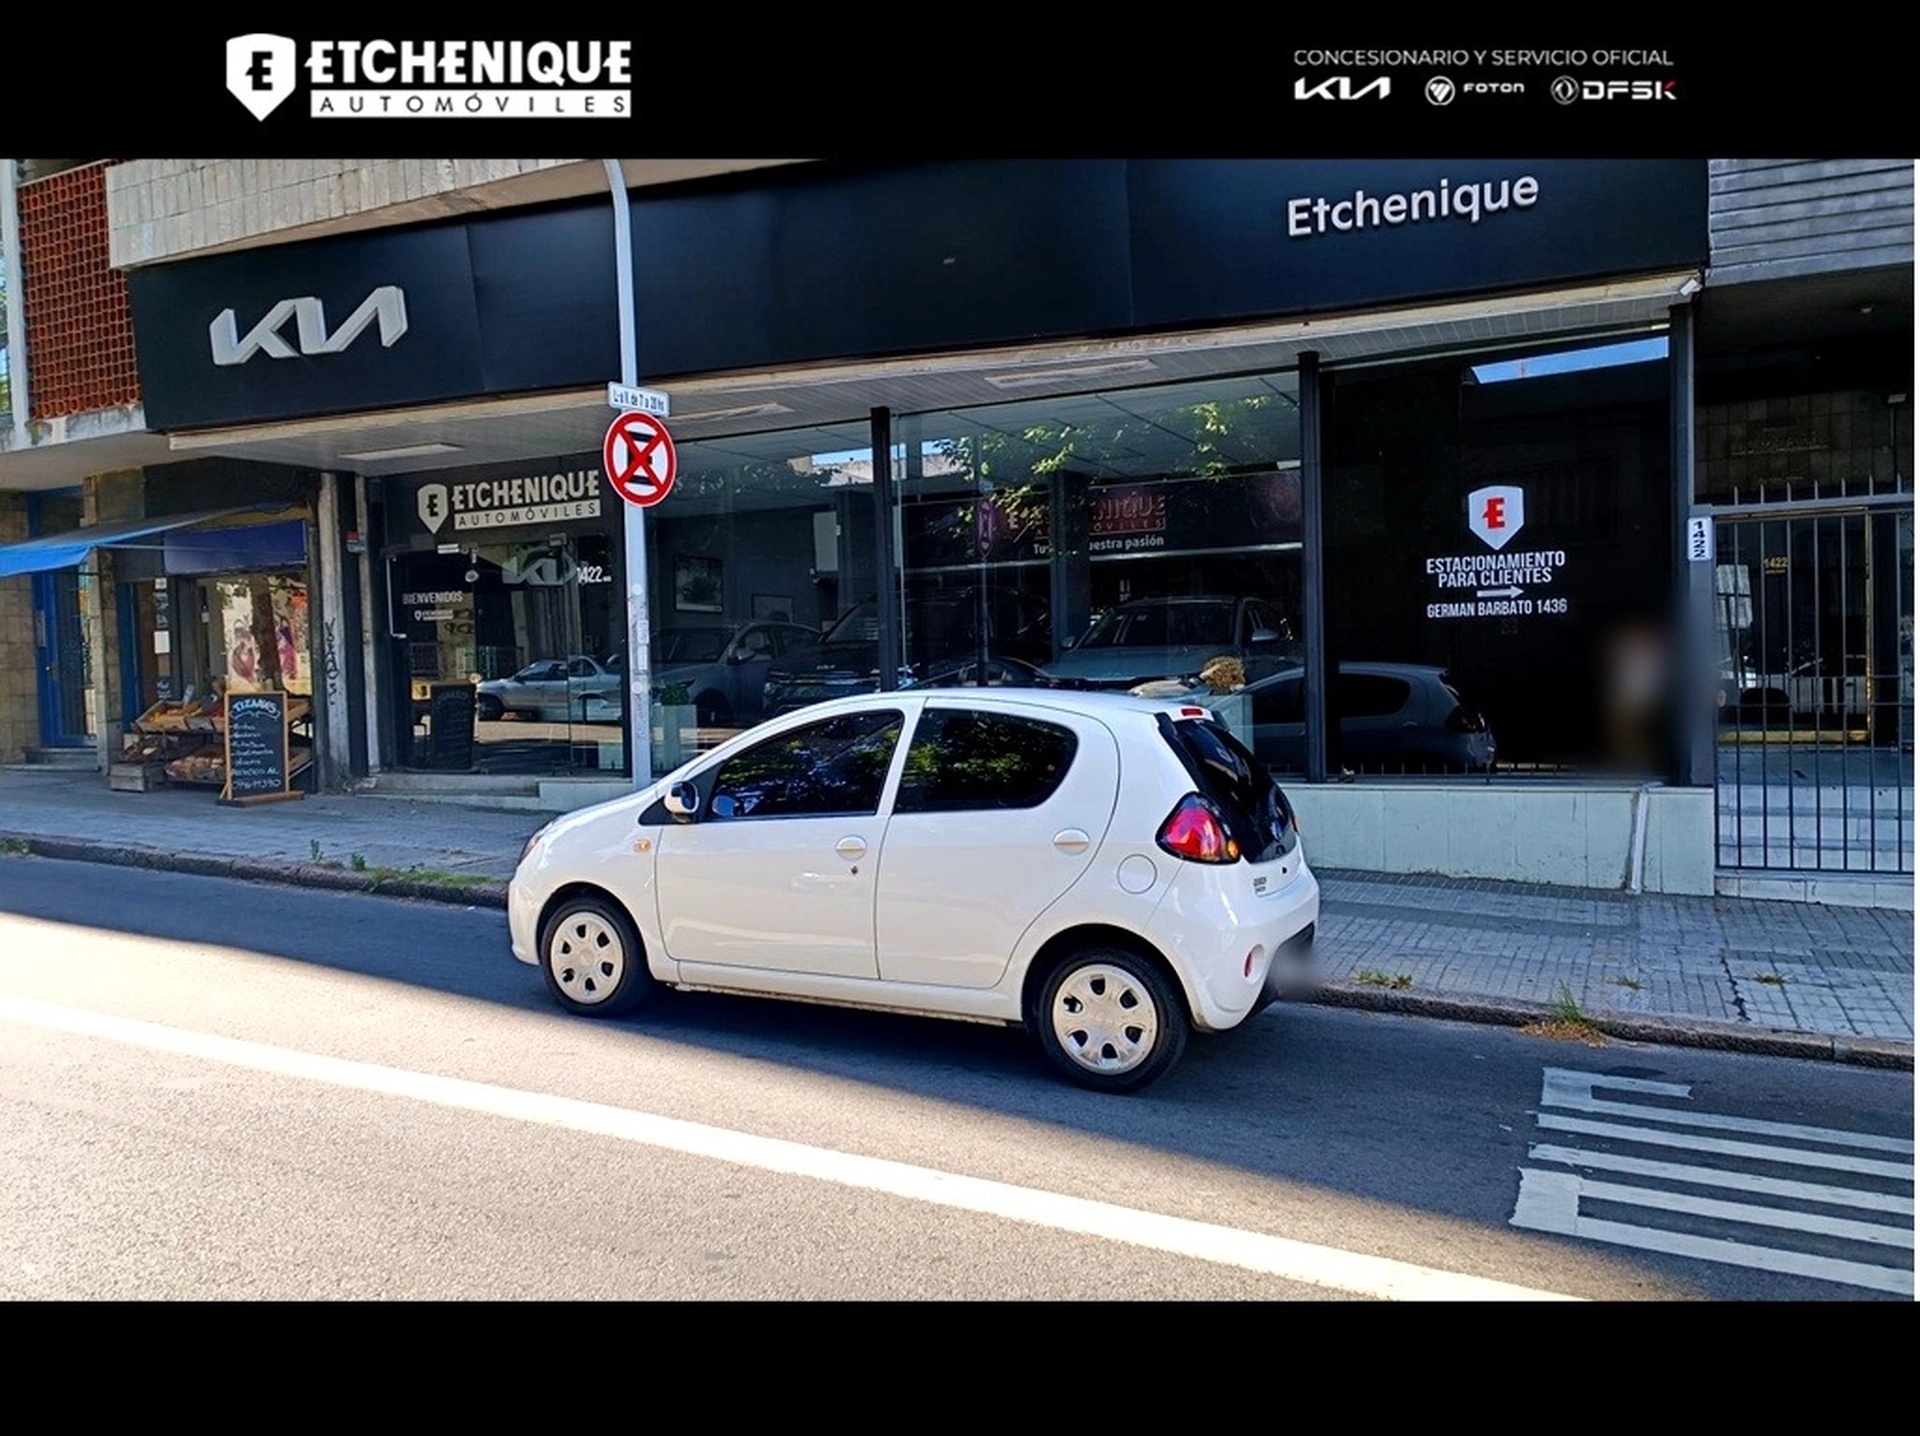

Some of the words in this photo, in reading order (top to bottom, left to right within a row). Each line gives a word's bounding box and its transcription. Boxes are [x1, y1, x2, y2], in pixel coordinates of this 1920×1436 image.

[1287, 173, 1540, 237] Etchenique
[209, 285, 408, 367] KIA
[452, 470, 599, 510] ETCHENIQUE
[458, 502, 596, 528] AUTOMÓVILES
[1125, 533, 1165, 550] pasión
[1426, 550, 1566, 574] ESTACIONAMIENTO
[1438, 572, 1477, 588] PARA
[1480, 567, 1552, 587] CLIENTES
[1427, 603, 1475, 618] GERMAN
[1478, 600, 1532, 616] BARBATO
[1537, 598, 1568, 614] 1436
